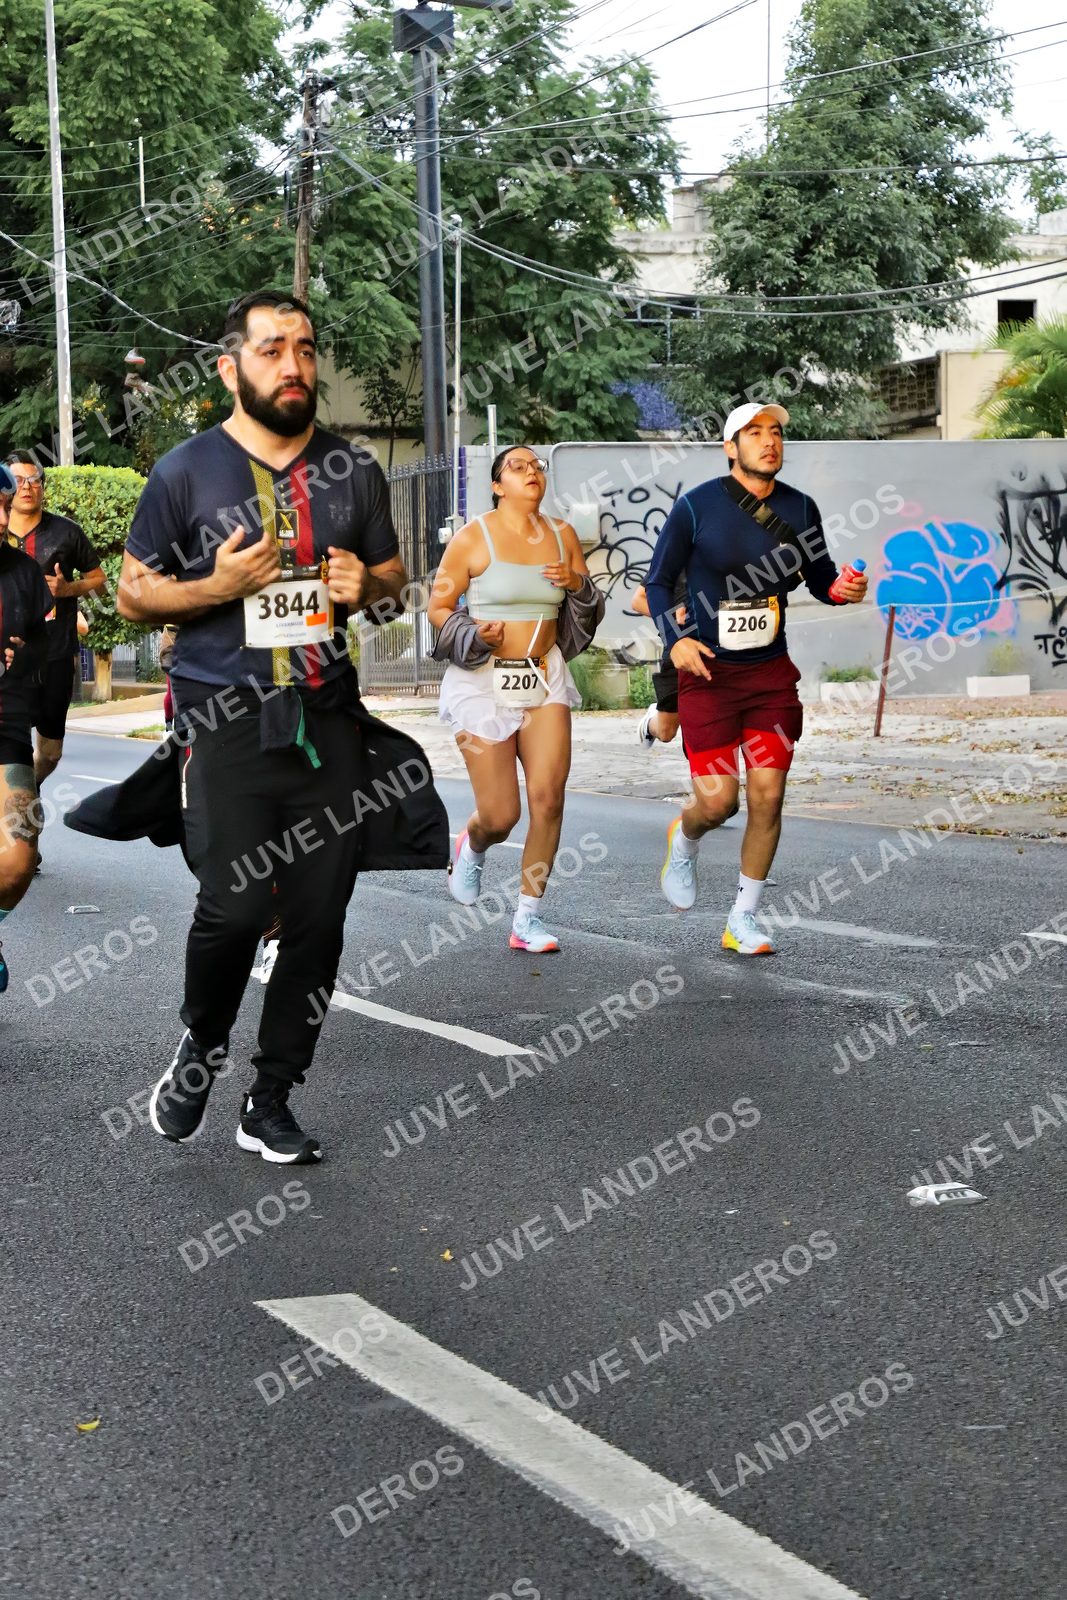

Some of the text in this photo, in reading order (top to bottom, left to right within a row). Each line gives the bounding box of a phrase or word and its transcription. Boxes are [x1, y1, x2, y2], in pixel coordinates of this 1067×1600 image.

[257, 590, 320, 620] 3844
[727, 615, 767, 633] 2206
[501, 673, 539, 690] 2207
